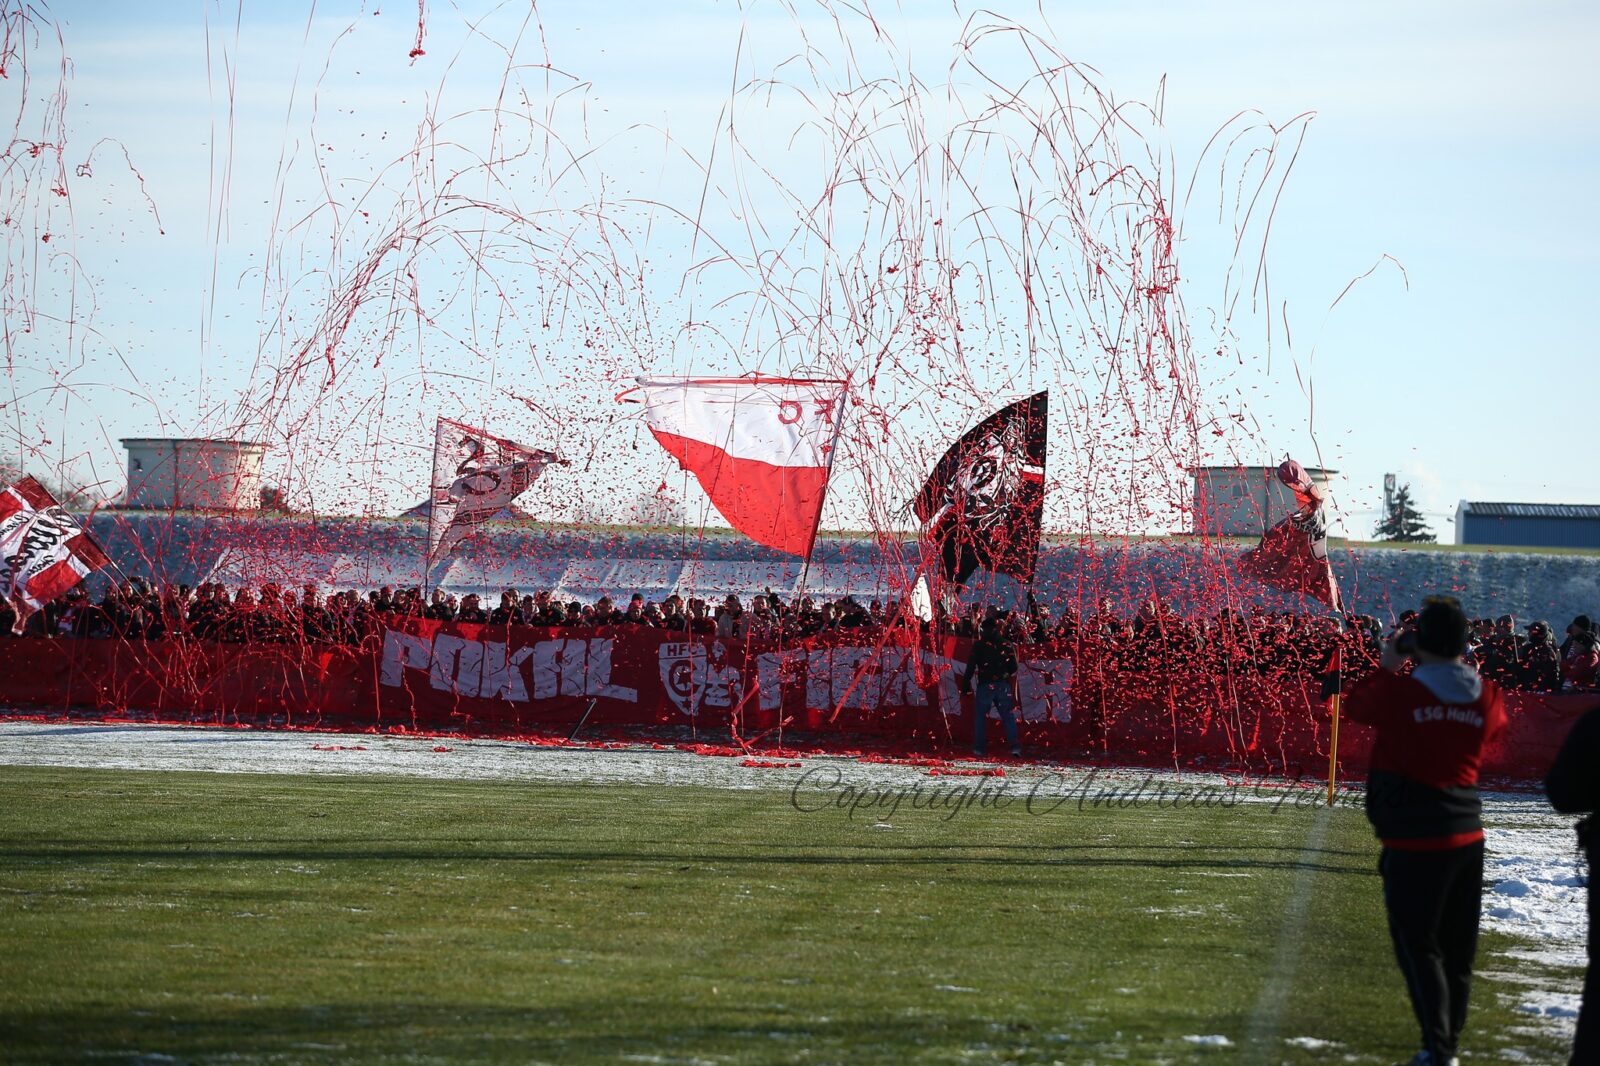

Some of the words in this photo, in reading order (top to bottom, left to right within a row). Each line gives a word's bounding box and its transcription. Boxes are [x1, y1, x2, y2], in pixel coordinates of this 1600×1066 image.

[666, 644, 698, 657] HFC
[380, 628, 638, 703] POKAL
[1413, 706, 1444, 724] ESG
[1447, 706, 1484, 729] Halle
